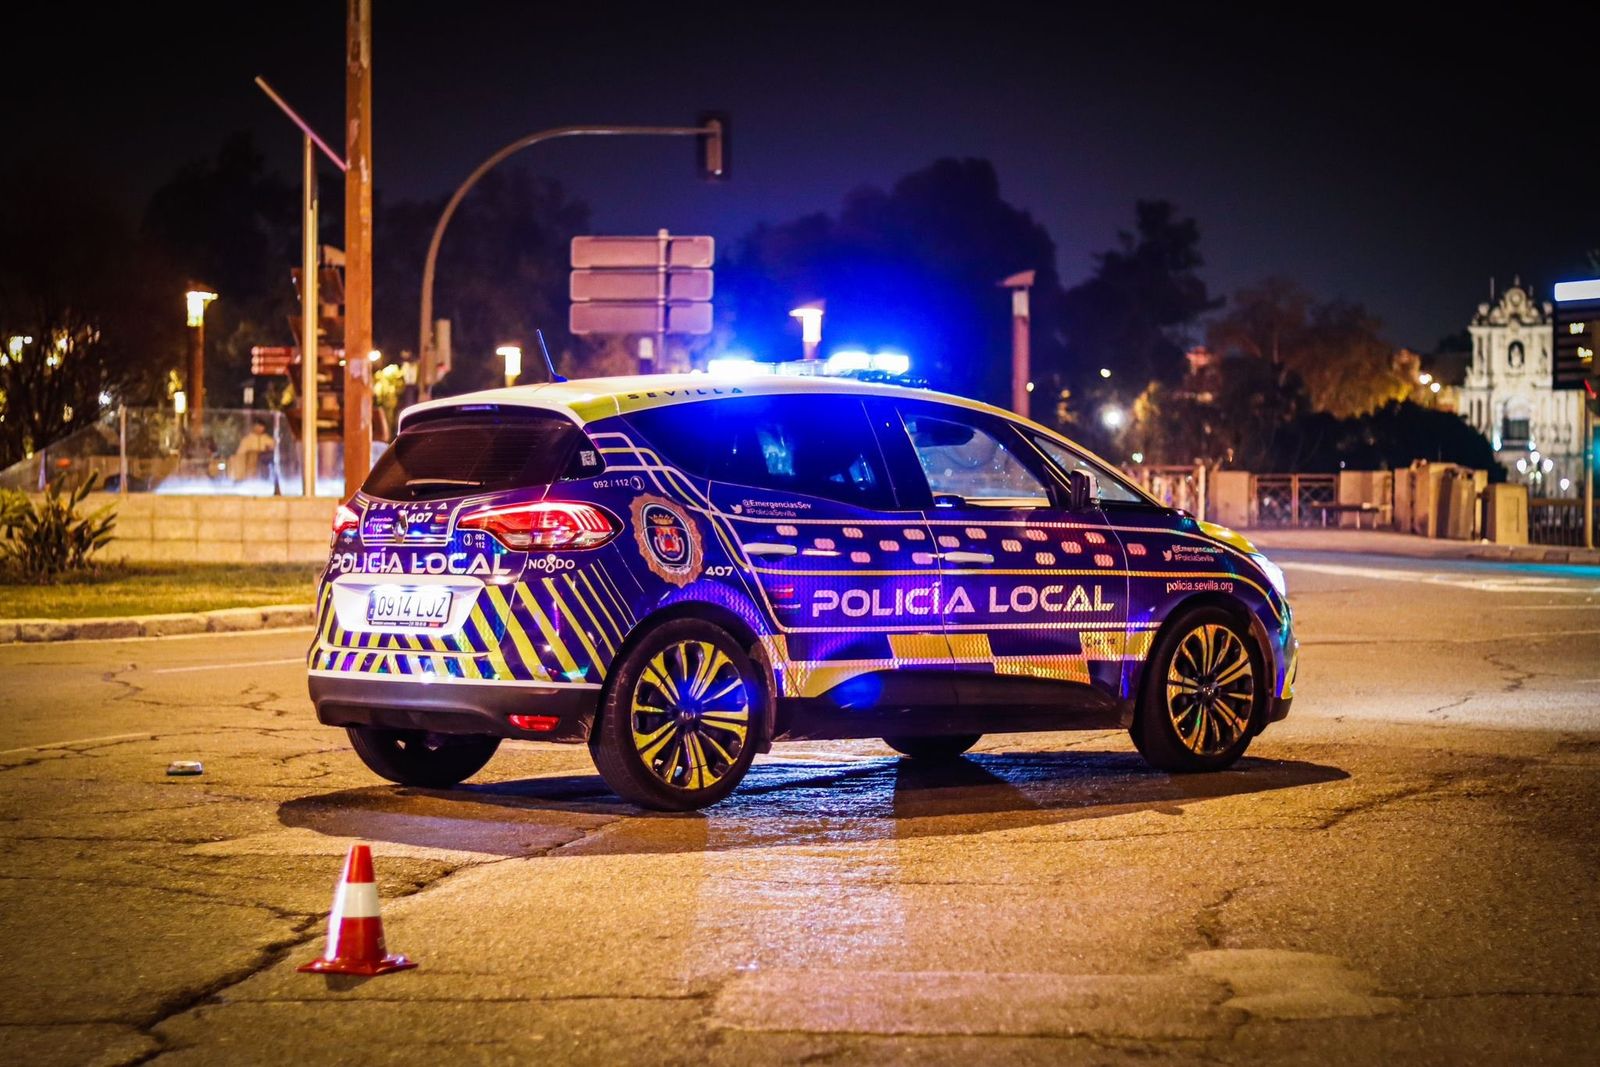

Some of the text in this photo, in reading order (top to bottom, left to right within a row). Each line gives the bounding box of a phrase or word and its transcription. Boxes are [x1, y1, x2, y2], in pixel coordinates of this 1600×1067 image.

[627, 387, 743, 399] SEVILLA
[593, 480, 609, 489] 092
[616, 479, 630, 487] 112
[370, 502, 448, 511] SEVILLA
[408, 512, 433, 523] 407
[474, 533, 486, 541] 092
[475, 541, 486, 549] 112
[329, 546, 512, 576] POLICÍA LOCAL
[705, 566, 734, 577] 407
[1166, 580, 1234, 594] policia.sevilla.org
[811, 581, 1115, 618] POLICÍA LOCAL
[377, 595, 447, 618] 0914 LJZ
